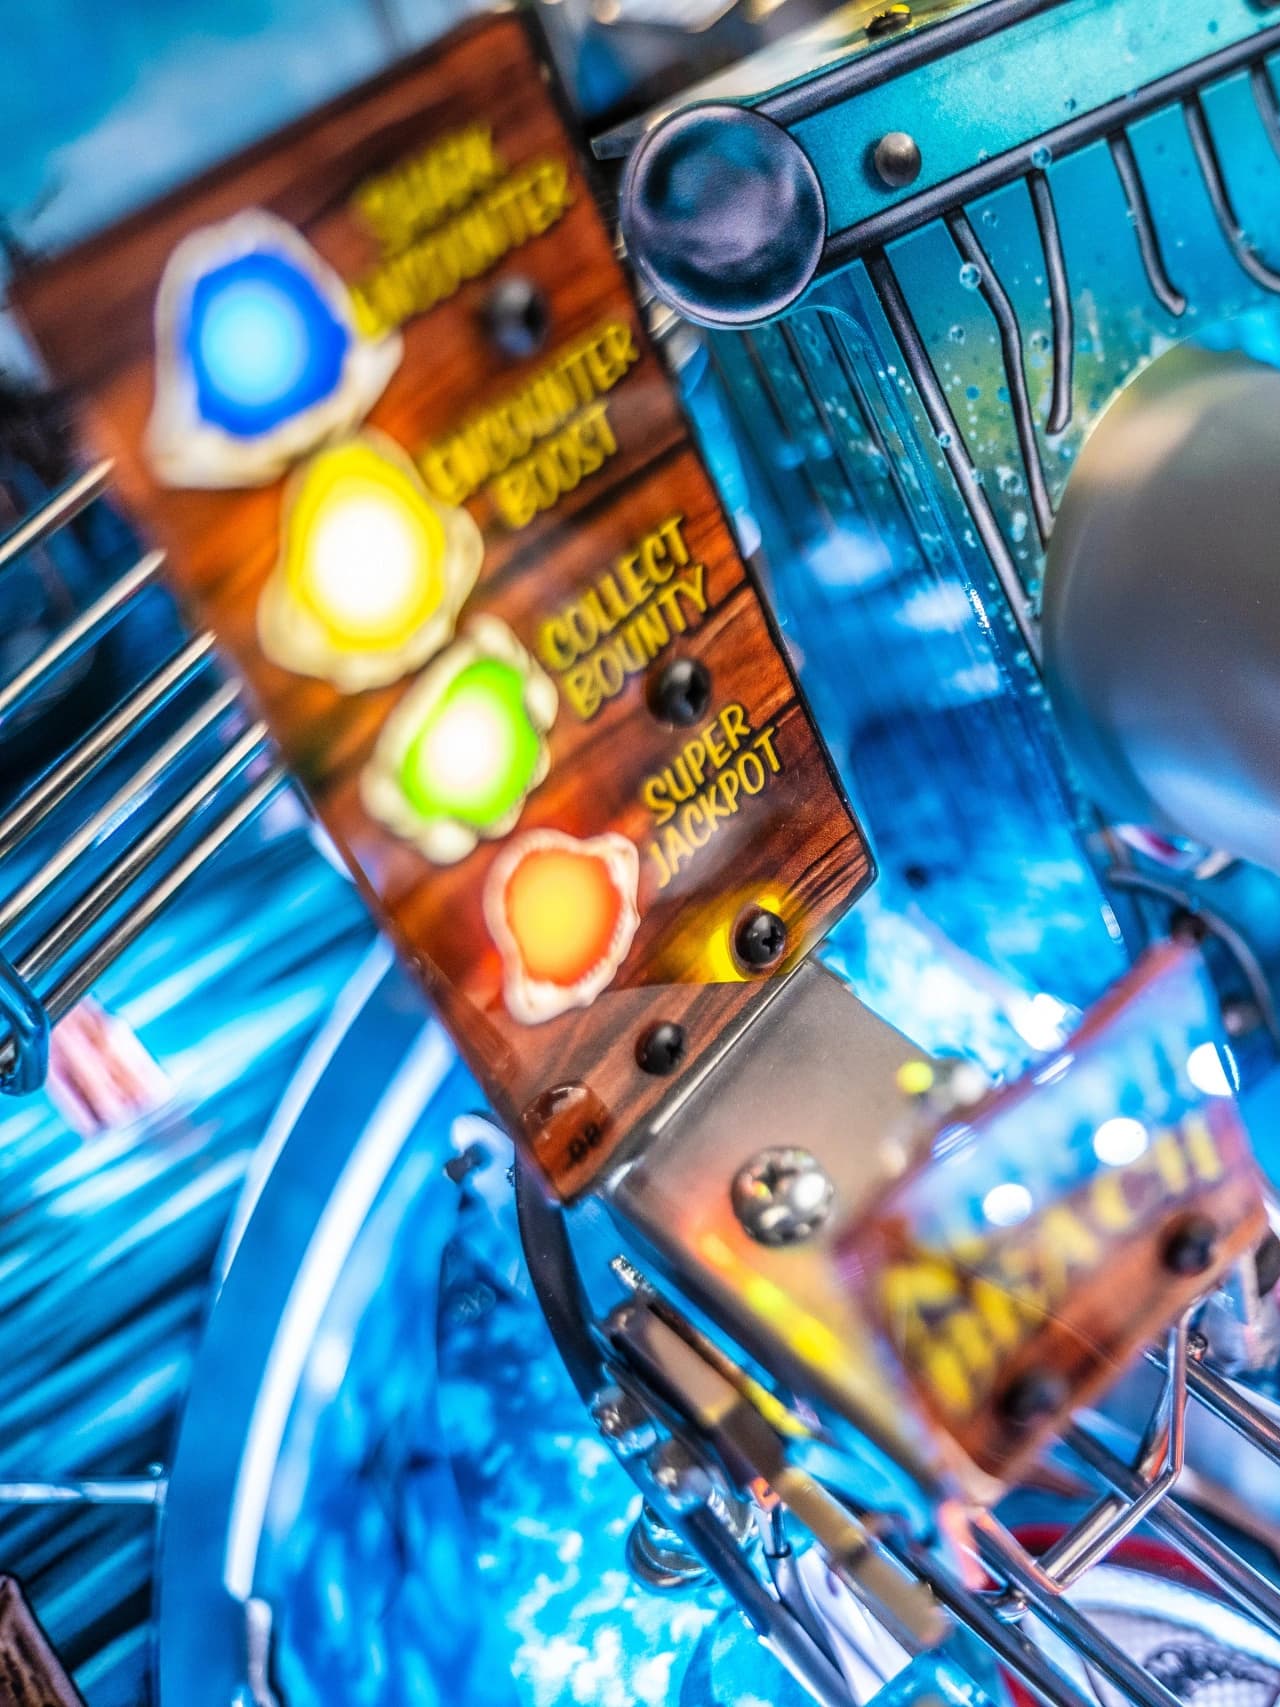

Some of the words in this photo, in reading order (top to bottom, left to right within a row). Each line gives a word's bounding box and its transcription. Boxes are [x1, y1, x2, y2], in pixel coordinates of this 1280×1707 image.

[421, 322, 638, 506] ENCOUNTER
[496, 403, 617, 529] BOOST
[538, 516, 691, 672] COLLECT
[564, 564, 709, 720] BOUNTY
[643, 703, 751, 827] SUPER
[650, 727, 783, 888] JACKPOT
